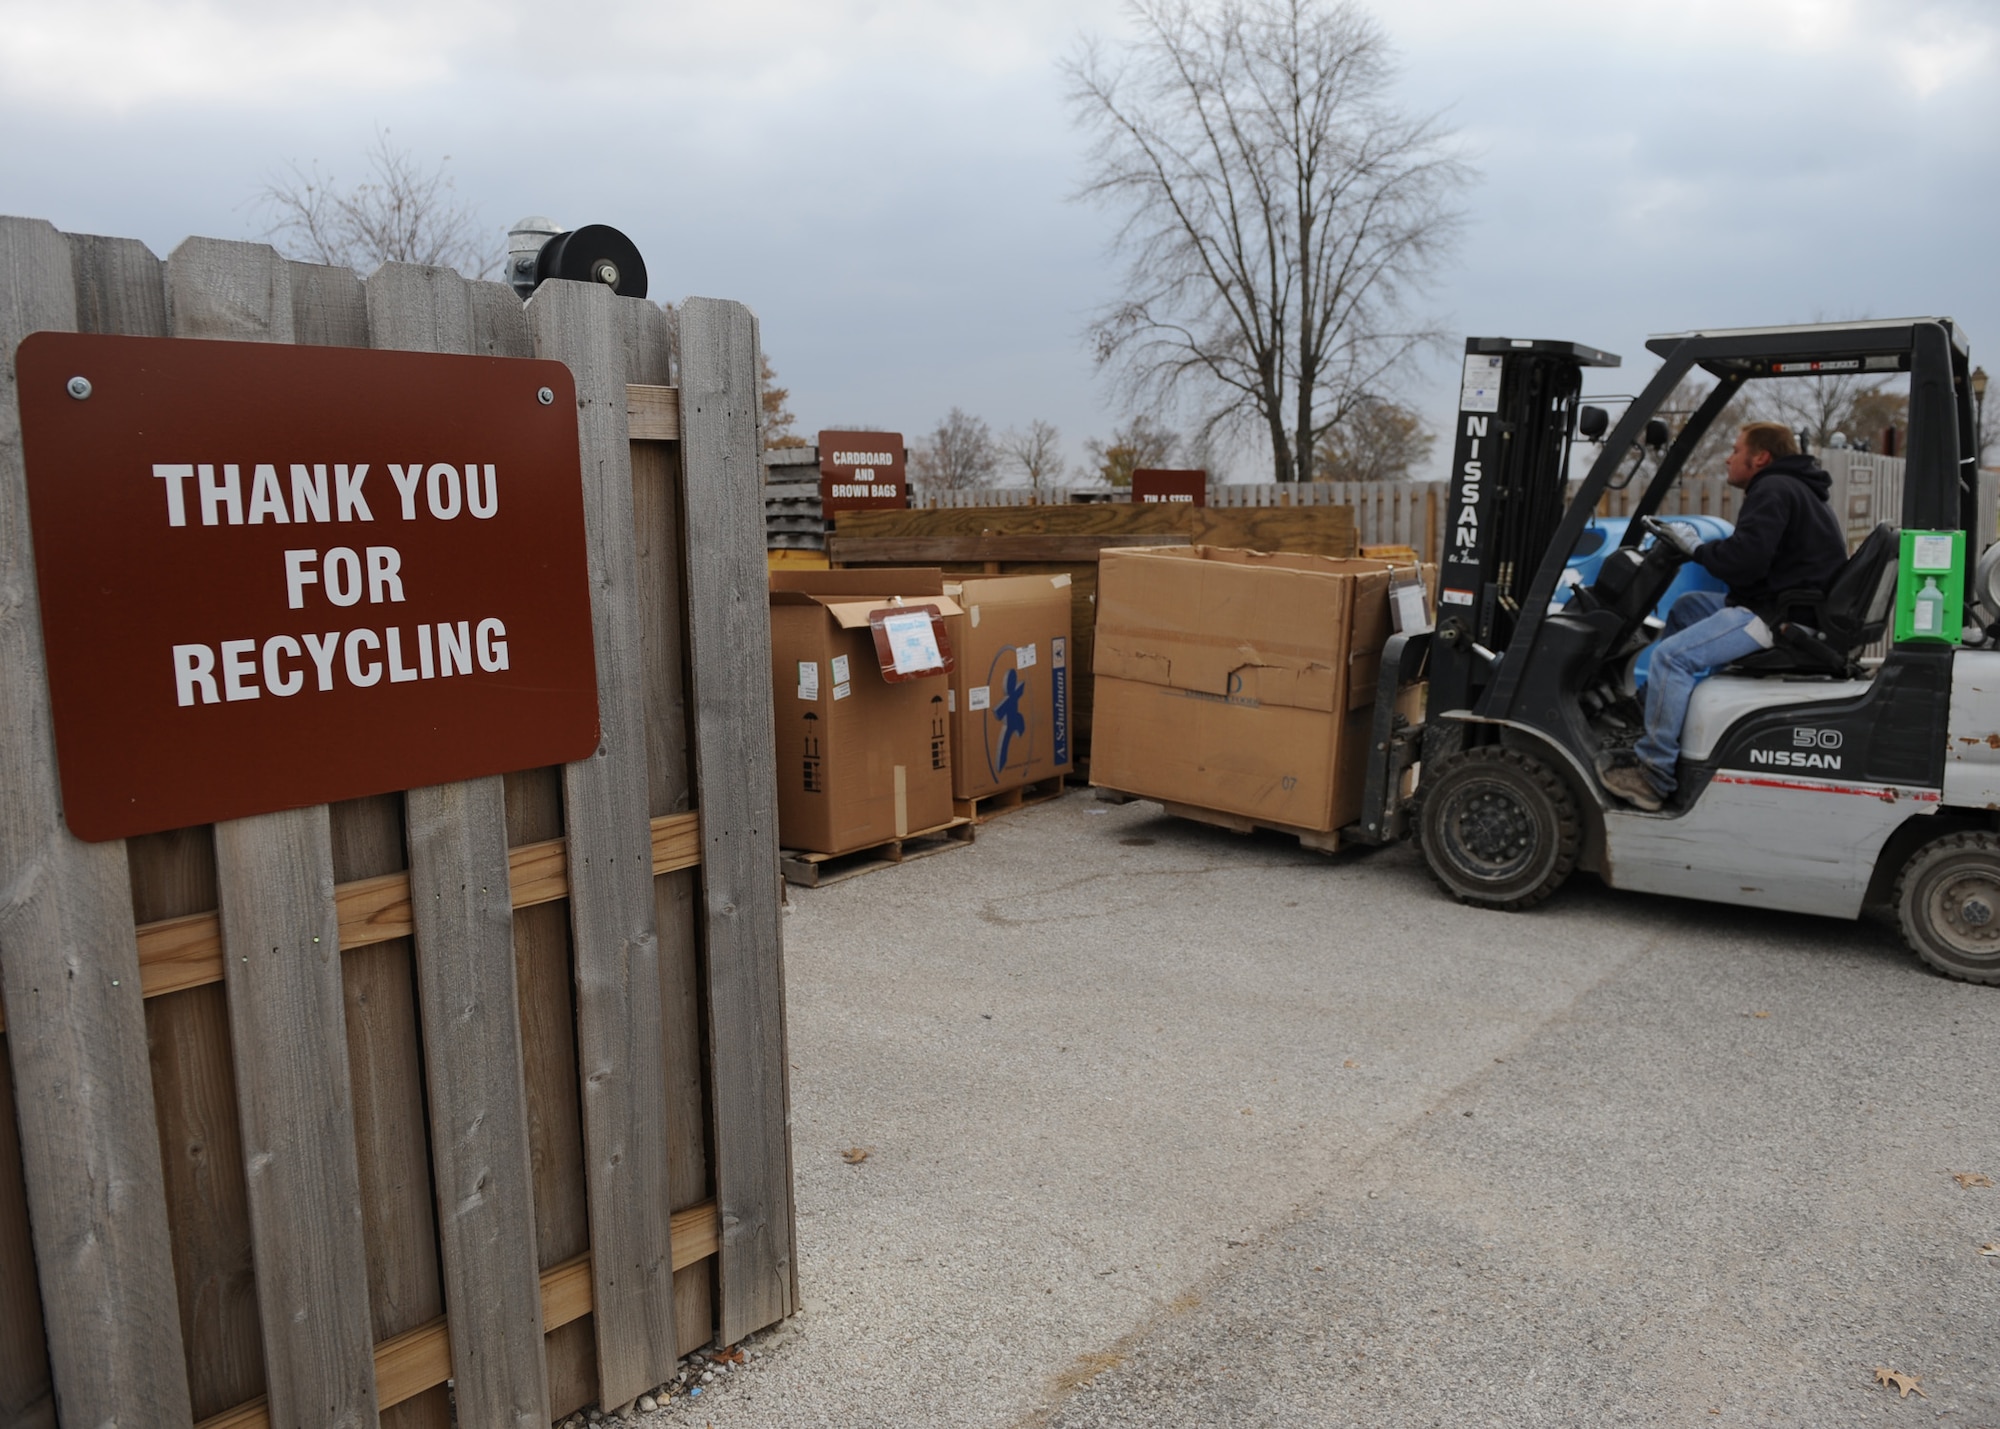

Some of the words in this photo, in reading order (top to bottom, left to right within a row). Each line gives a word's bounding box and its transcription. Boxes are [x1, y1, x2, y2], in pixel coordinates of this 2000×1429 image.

[832, 451, 893, 466] CARDBOARD
[854, 468, 875, 481] AND
[152, 463, 374, 527] THANK
[388, 463, 498, 520] YOU
[832, 485, 869, 498] BROWN
[871, 484, 897, 498] BAGS
[1456, 415, 1488, 548] NISSAN
[285, 546, 406, 609] FOR
[172, 617, 510, 707] RECYCLING
[1055, 671, 1066, 742] Schulman
[1749, 748, 1842, 771] NISSAN
[1792, 727, 1843, 750] 50
